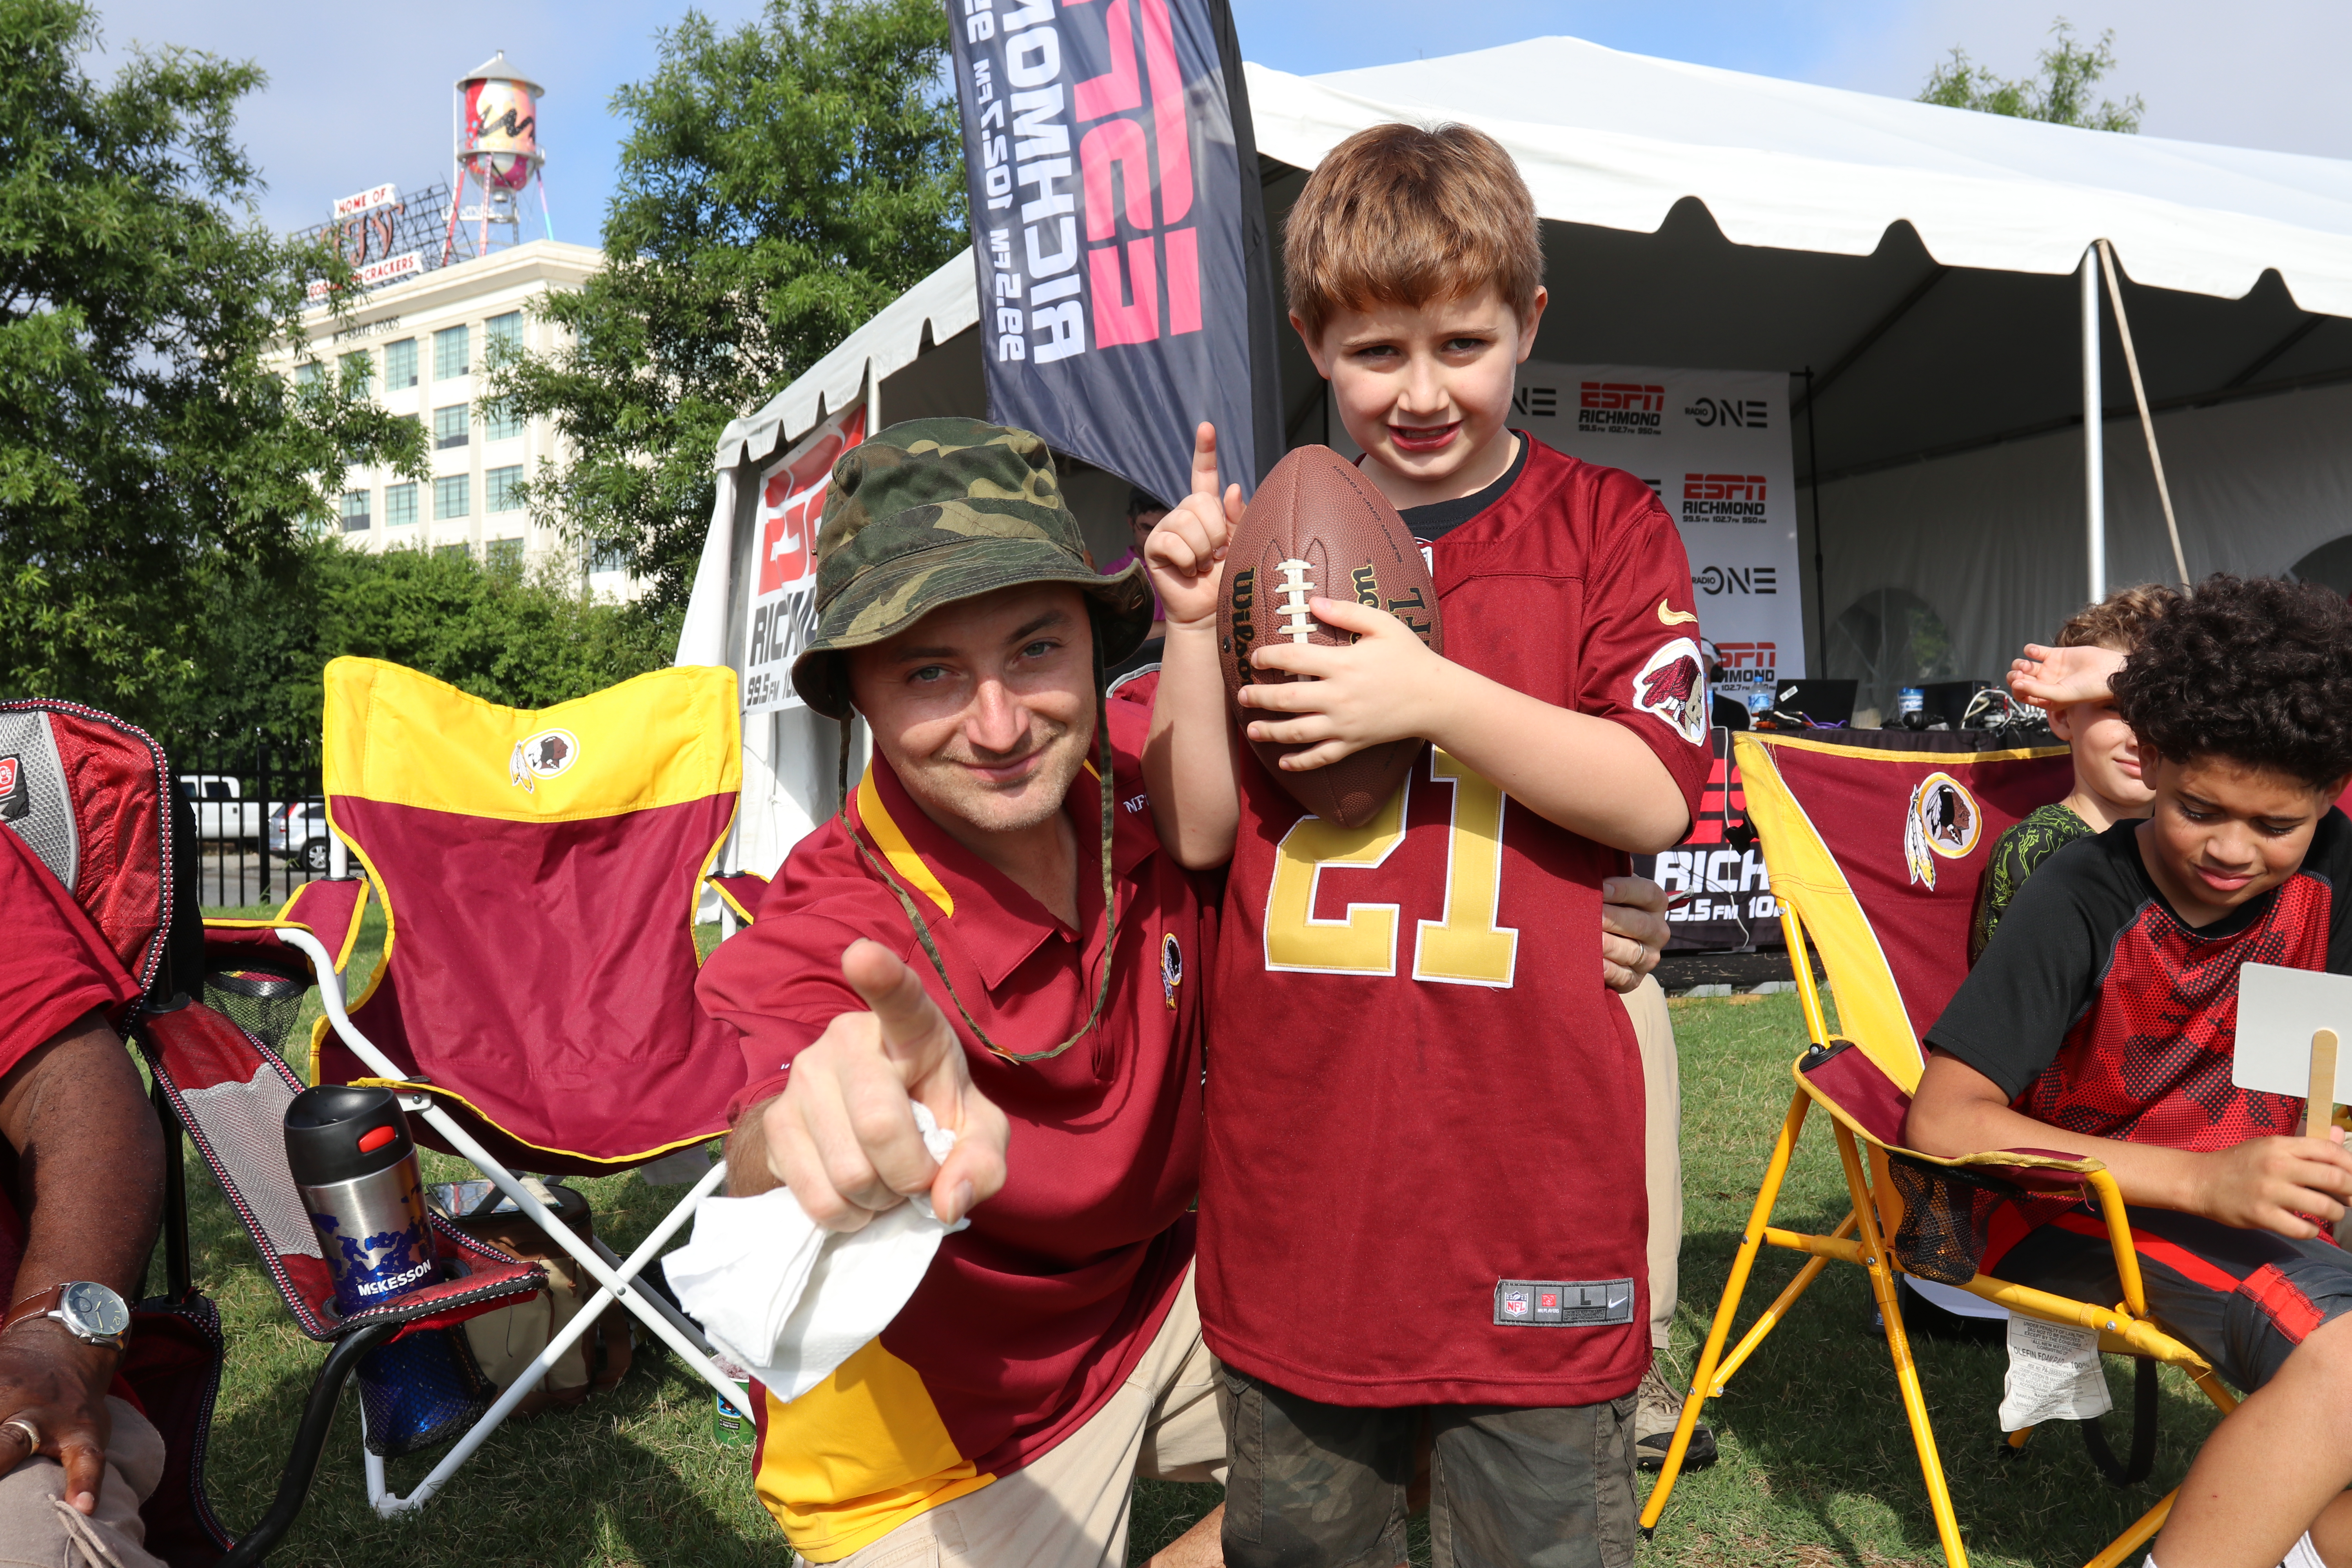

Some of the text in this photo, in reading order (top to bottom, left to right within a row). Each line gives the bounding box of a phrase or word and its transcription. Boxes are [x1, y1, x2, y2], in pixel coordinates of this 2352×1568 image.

[338, 187, 386, 215] HOME OF
[365, 255, 414, 281] CRACKERS
[1512, 387, 1557, 416] NE
[1581, 381, 1665, 412] ESPN
[1578, 409, 1661, 426] RICHMOND
[1685, 397, 1768, 428] RADIO ONE
[1684, 473, 1767, 501] ESPN
[758, 403, 866, 596] ESP
[1682, 501, 1766, 515] RICHMOND
[1333, 465, 1403, 563] SUPER GRIP COVER
[1702, 565, 1777, 595] ONE
[1387, 587, 1434, 647] FL
[1714, 642, 1776, 668] SPN
[1123, 792, 1149, 814] NF
[1263, 742, 1519, 989] 21
[1506, 1301, 1525, 1312] NFL
[1580, 1288, 1592, 1306] L
[113, 1316, 122, 1326] 12
[2040, 1325, 2058, 1333] PENALTY
[2037, 1345, 2063, 1355] CONSISTING
[2060, 1335, 2081, 1343] REMOVED
[2014, 1346, 2036, 1359] OLEFIN
[2038, 1352, 2054, 1363] FOAM
[2053, 1356, 2065, 1366] PAD
[2071, 1361, 2090, 1369] 100%
[2019, 1367, 2045, 1379] CERTIFICATION
[2025, 1379, 2043, 1388] ARTICLE
[2016, 1392, 2038, 1402] RAWLINGS
